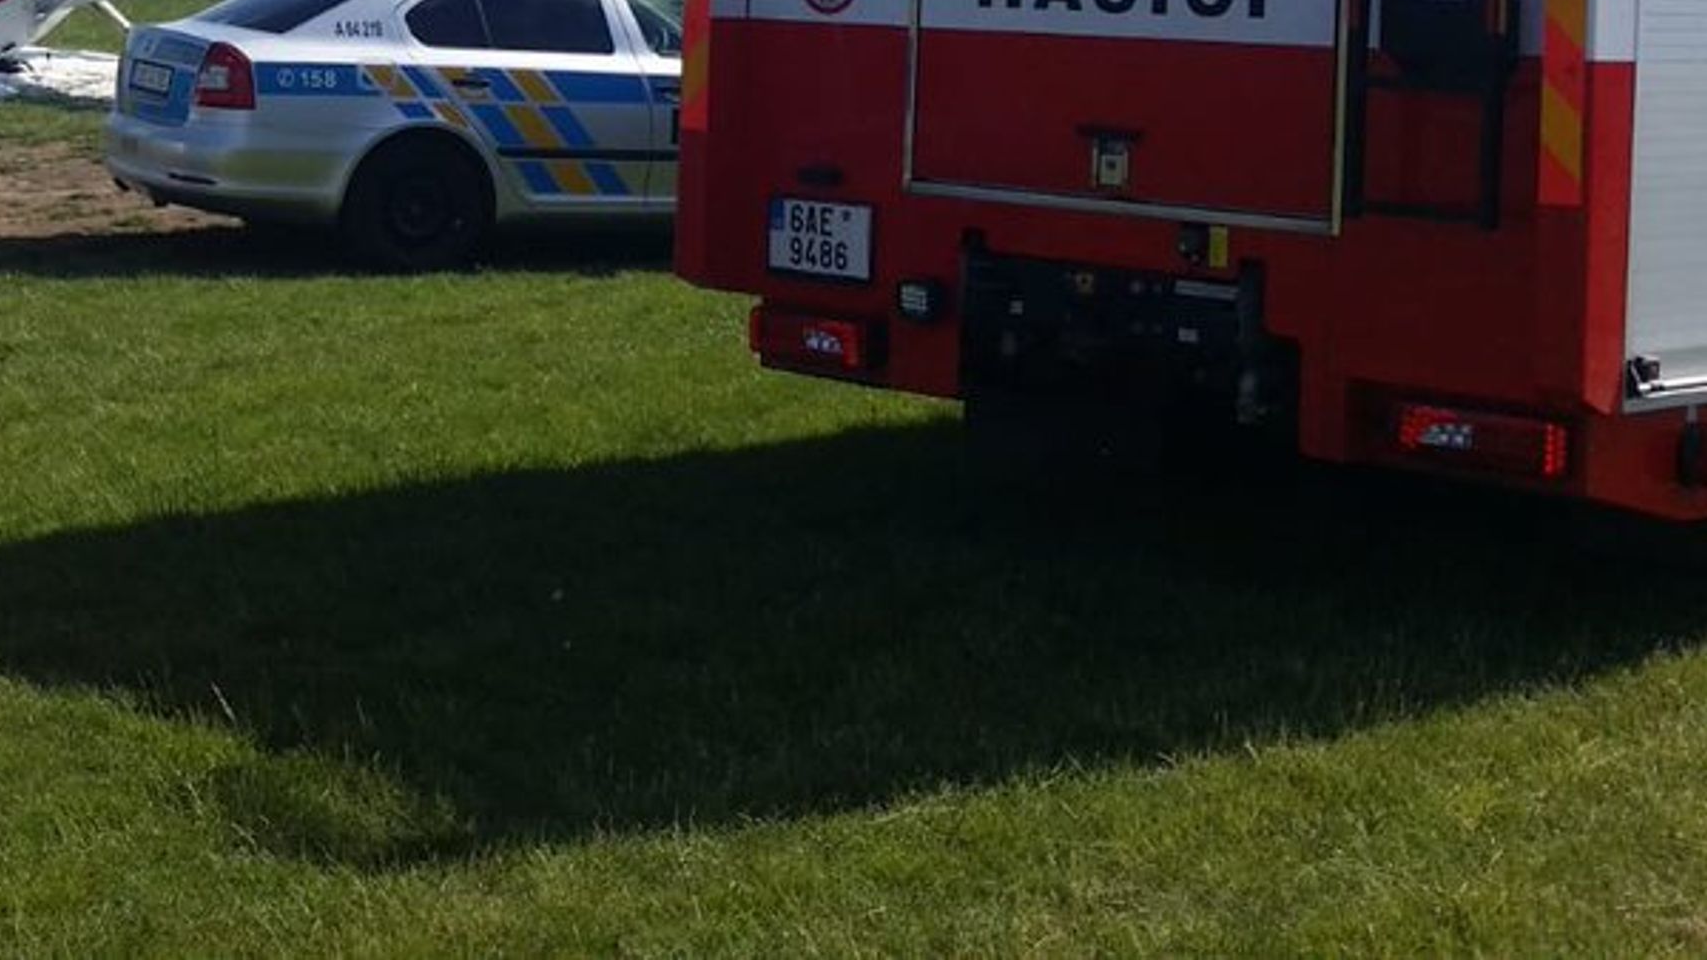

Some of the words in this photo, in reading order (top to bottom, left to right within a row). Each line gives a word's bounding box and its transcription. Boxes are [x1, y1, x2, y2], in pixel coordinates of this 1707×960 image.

[299, 70, 337, 88] 158
[791, 204, 834, 237] 6AE
[790, 237, 848, 271] 9486
